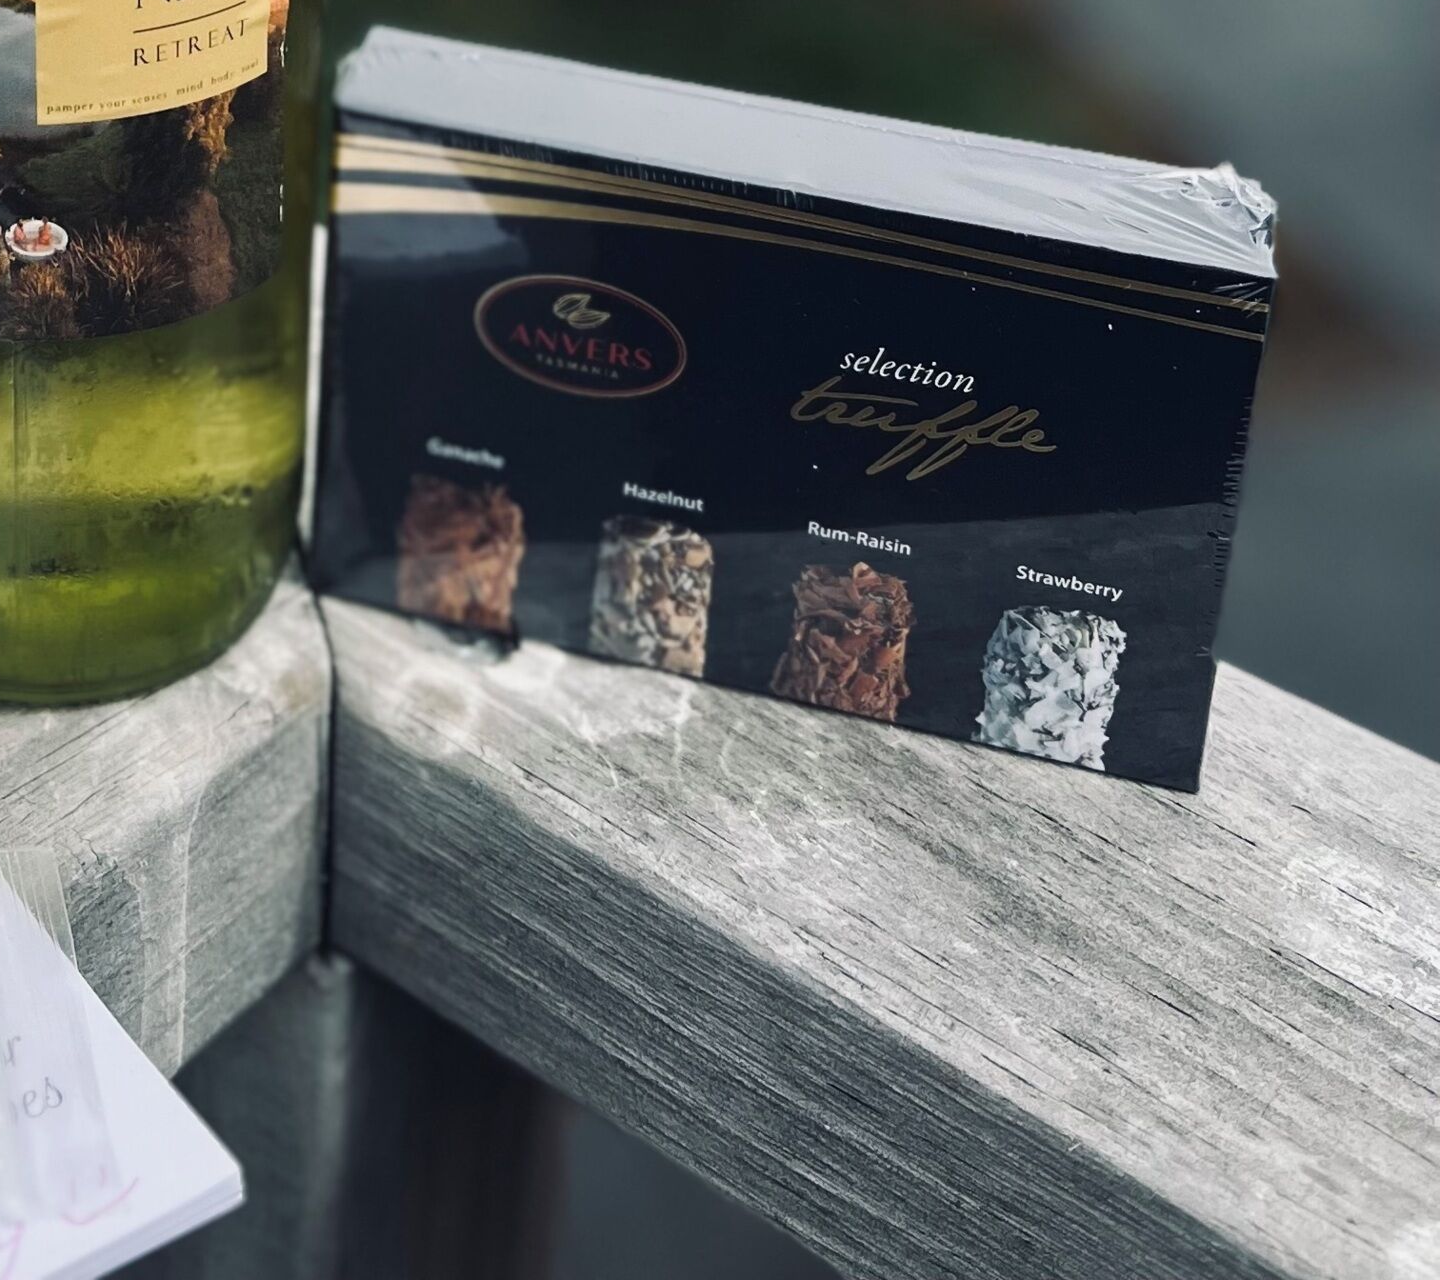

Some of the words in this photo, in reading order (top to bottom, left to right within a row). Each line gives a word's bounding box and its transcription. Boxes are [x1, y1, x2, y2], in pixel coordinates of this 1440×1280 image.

[133, 18, 249, 66] RETREAT
[46, 102, 94, 115] pamper
[176, 80, 204, 95] mind
[511, 323, 653, 371] ANVERS
[535, 353, 620, 380] TASMANIA
[839, 347, 976, 393] selection
[790, 375, 1057, 481] truffle
[622, 481, 705, 512] Hazelnut
[807, 520, 912, 556] Rum-Raisin
[1015, 564, 1124, 602] Strawberry
